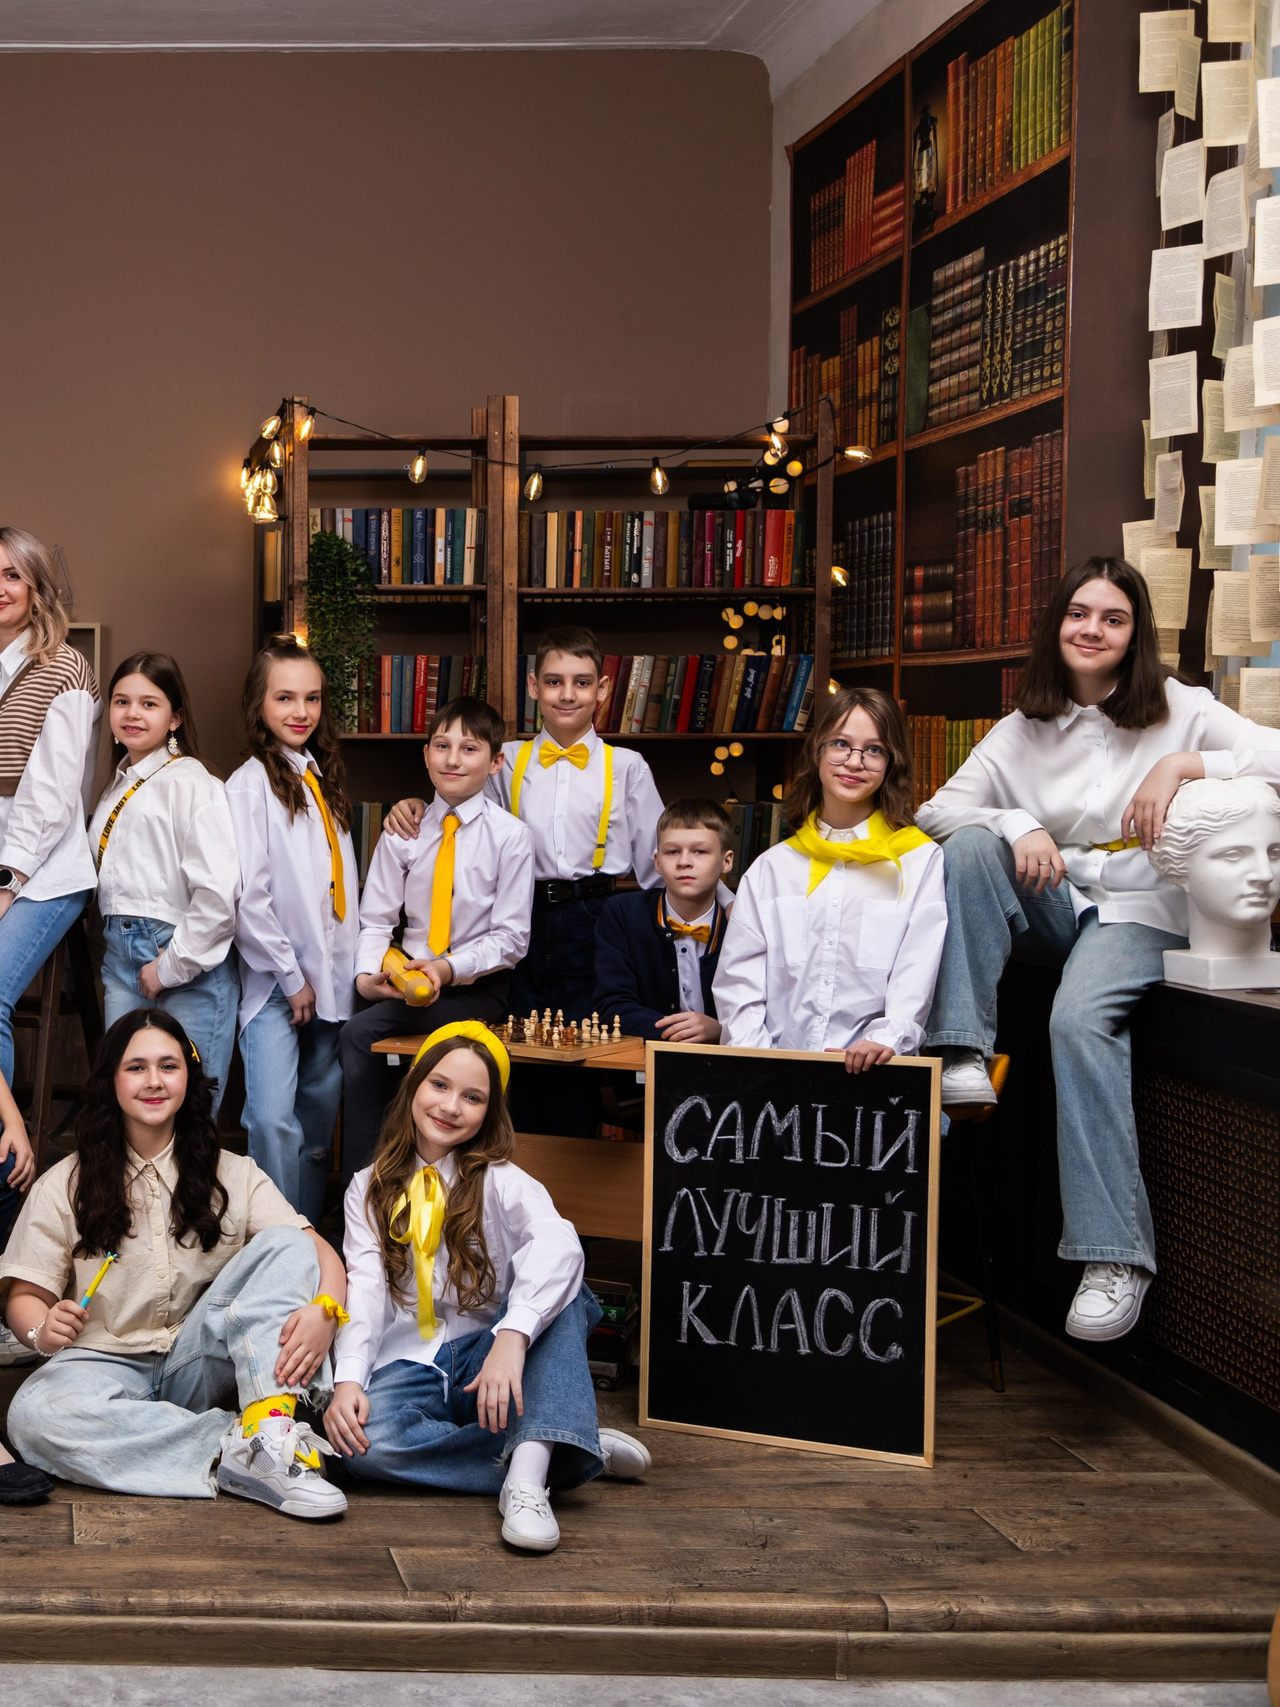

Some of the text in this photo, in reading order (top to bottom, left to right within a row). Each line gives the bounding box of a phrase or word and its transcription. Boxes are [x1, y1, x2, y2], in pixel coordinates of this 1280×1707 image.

[102, 817, 115, 839] LOVE
[112, 796, 127, 817] LOVE
[664, 1095, 922, 1173] САМЫЙ
[658, 1187, 919, 1274] ЛУЧШИЙ
[676, 1281, 906, 1364] КЛАСС
